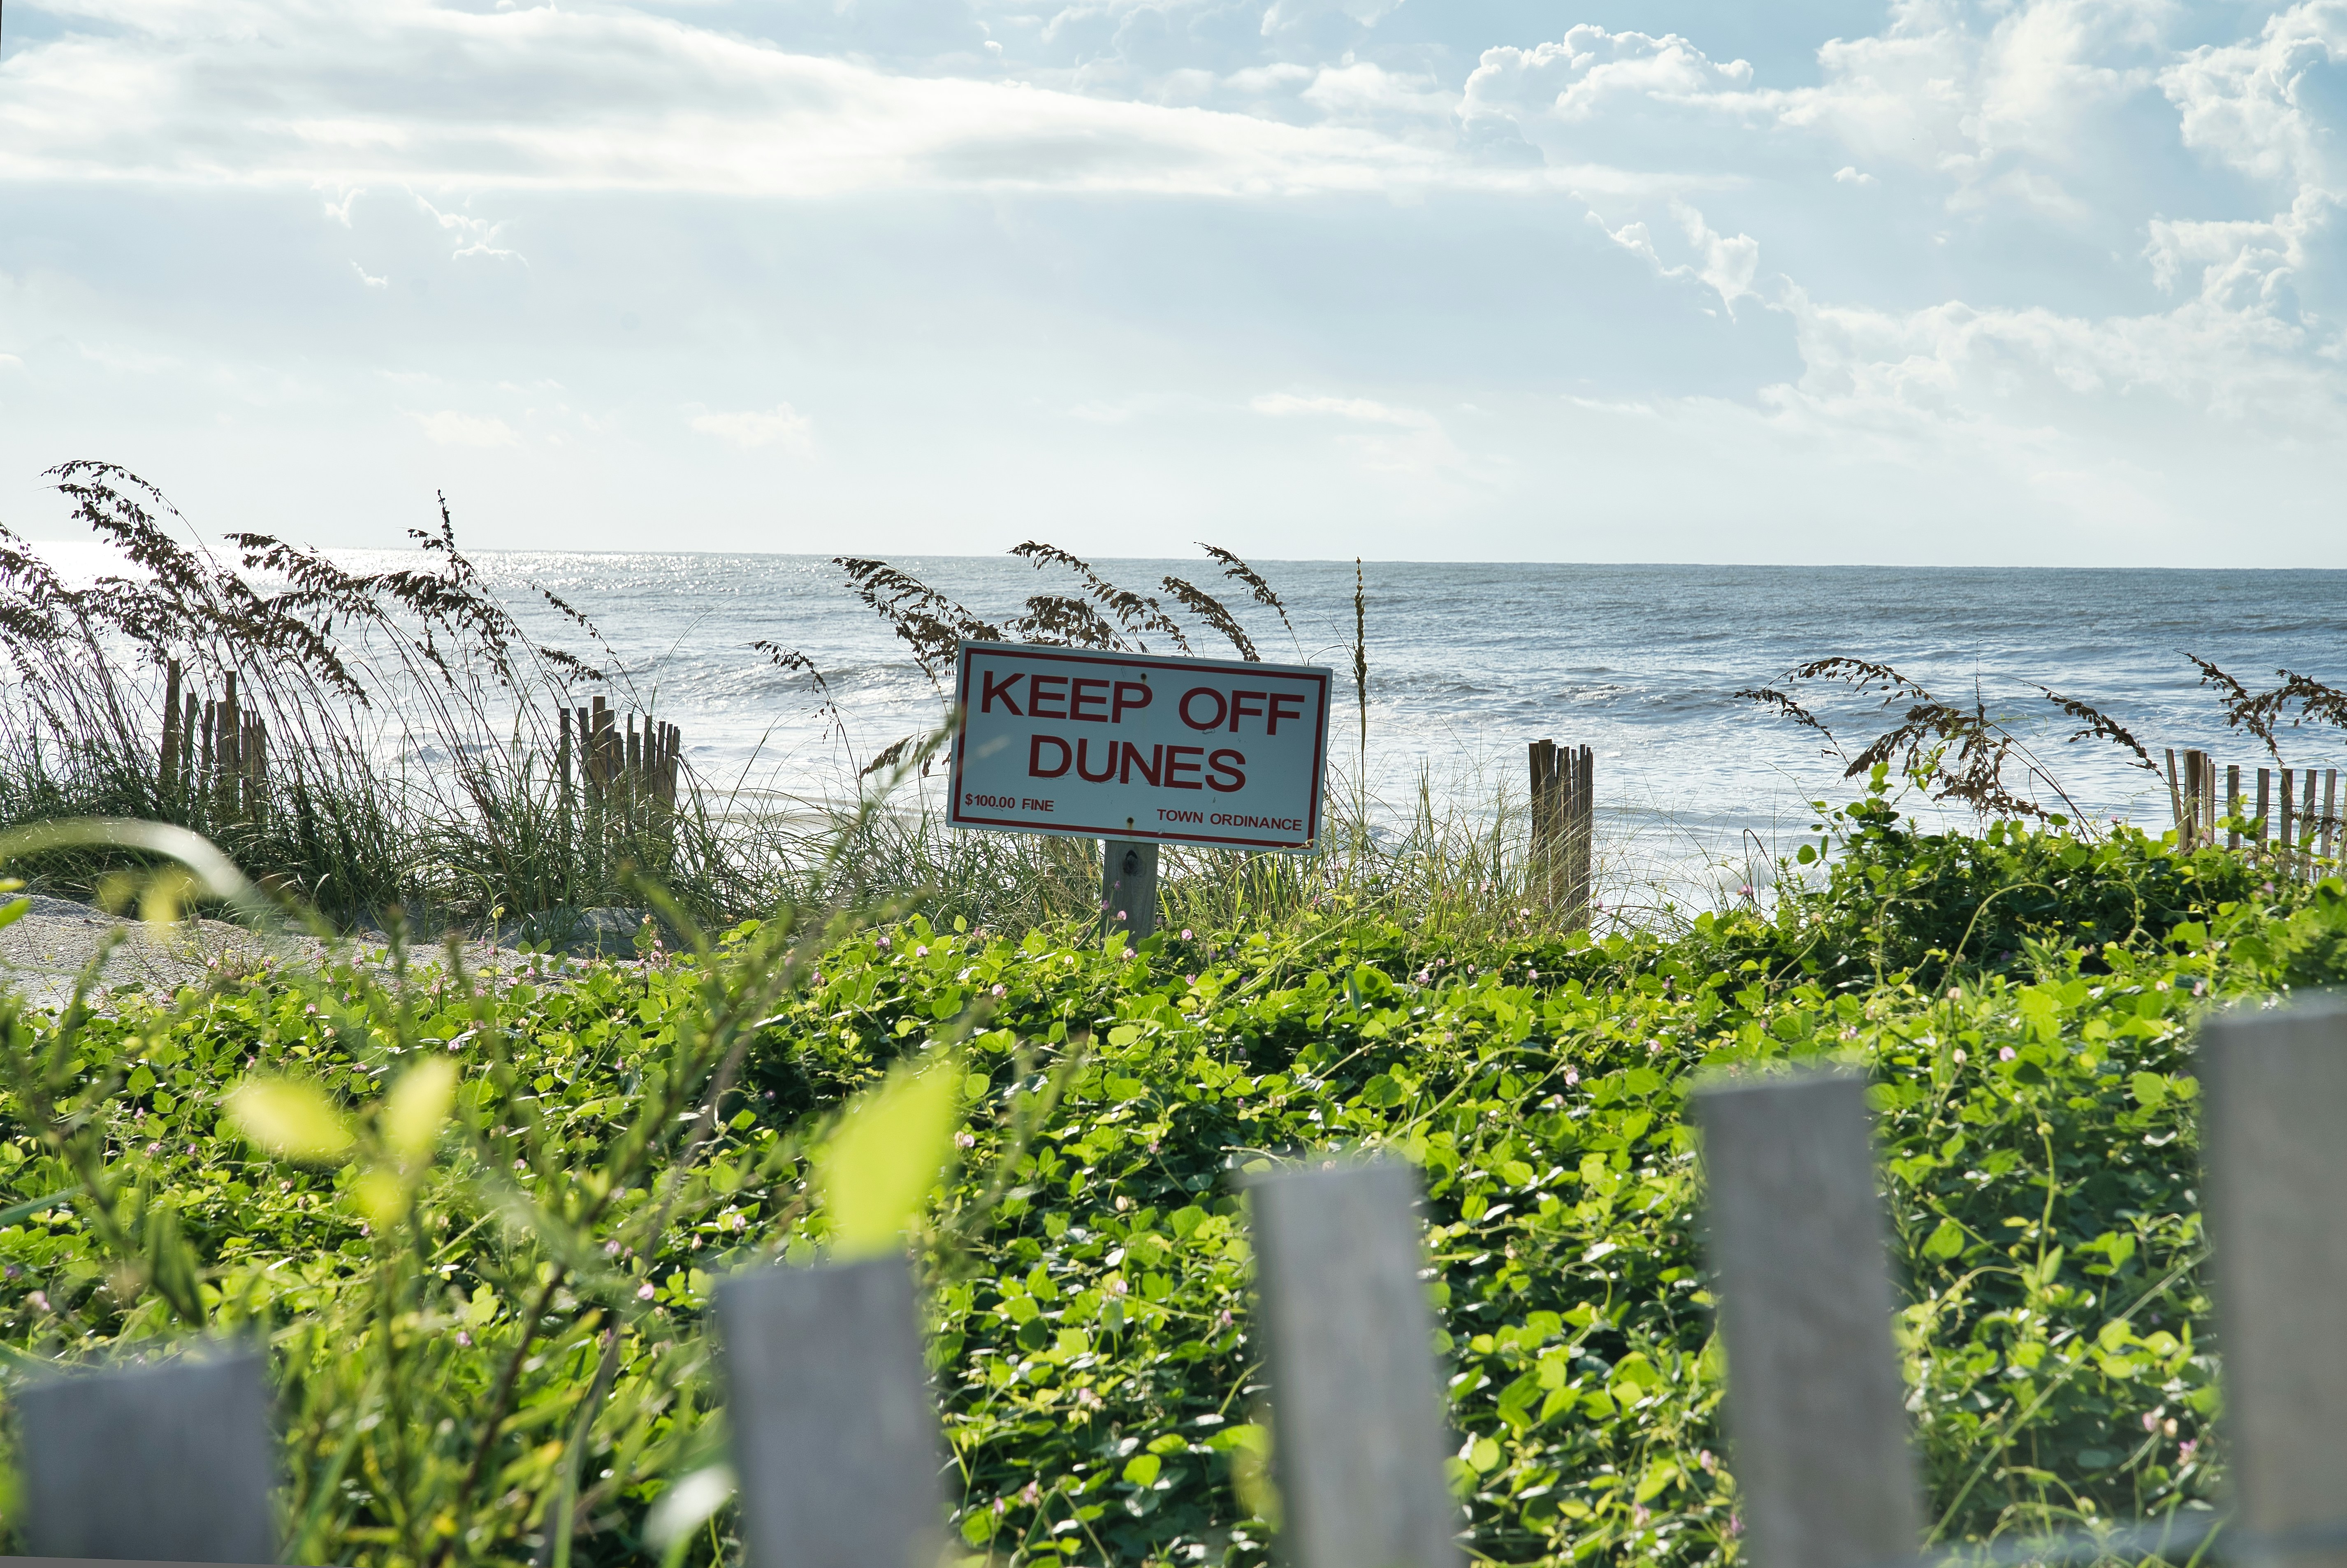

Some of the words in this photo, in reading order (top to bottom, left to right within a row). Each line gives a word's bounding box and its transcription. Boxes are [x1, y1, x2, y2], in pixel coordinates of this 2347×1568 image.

[981, 670, 1153, 724] KEEP
[1179, 687, 1305, 735] OFF
[1029, 734, 1246, 793] DUNES
[965, 793, 1015, 808] $100.00
[1022, 798, 1054, 812] FINE
[1157, 809, 1203, 823] TOWN
[1210, 813, 1302, 831] ORDINANCE
